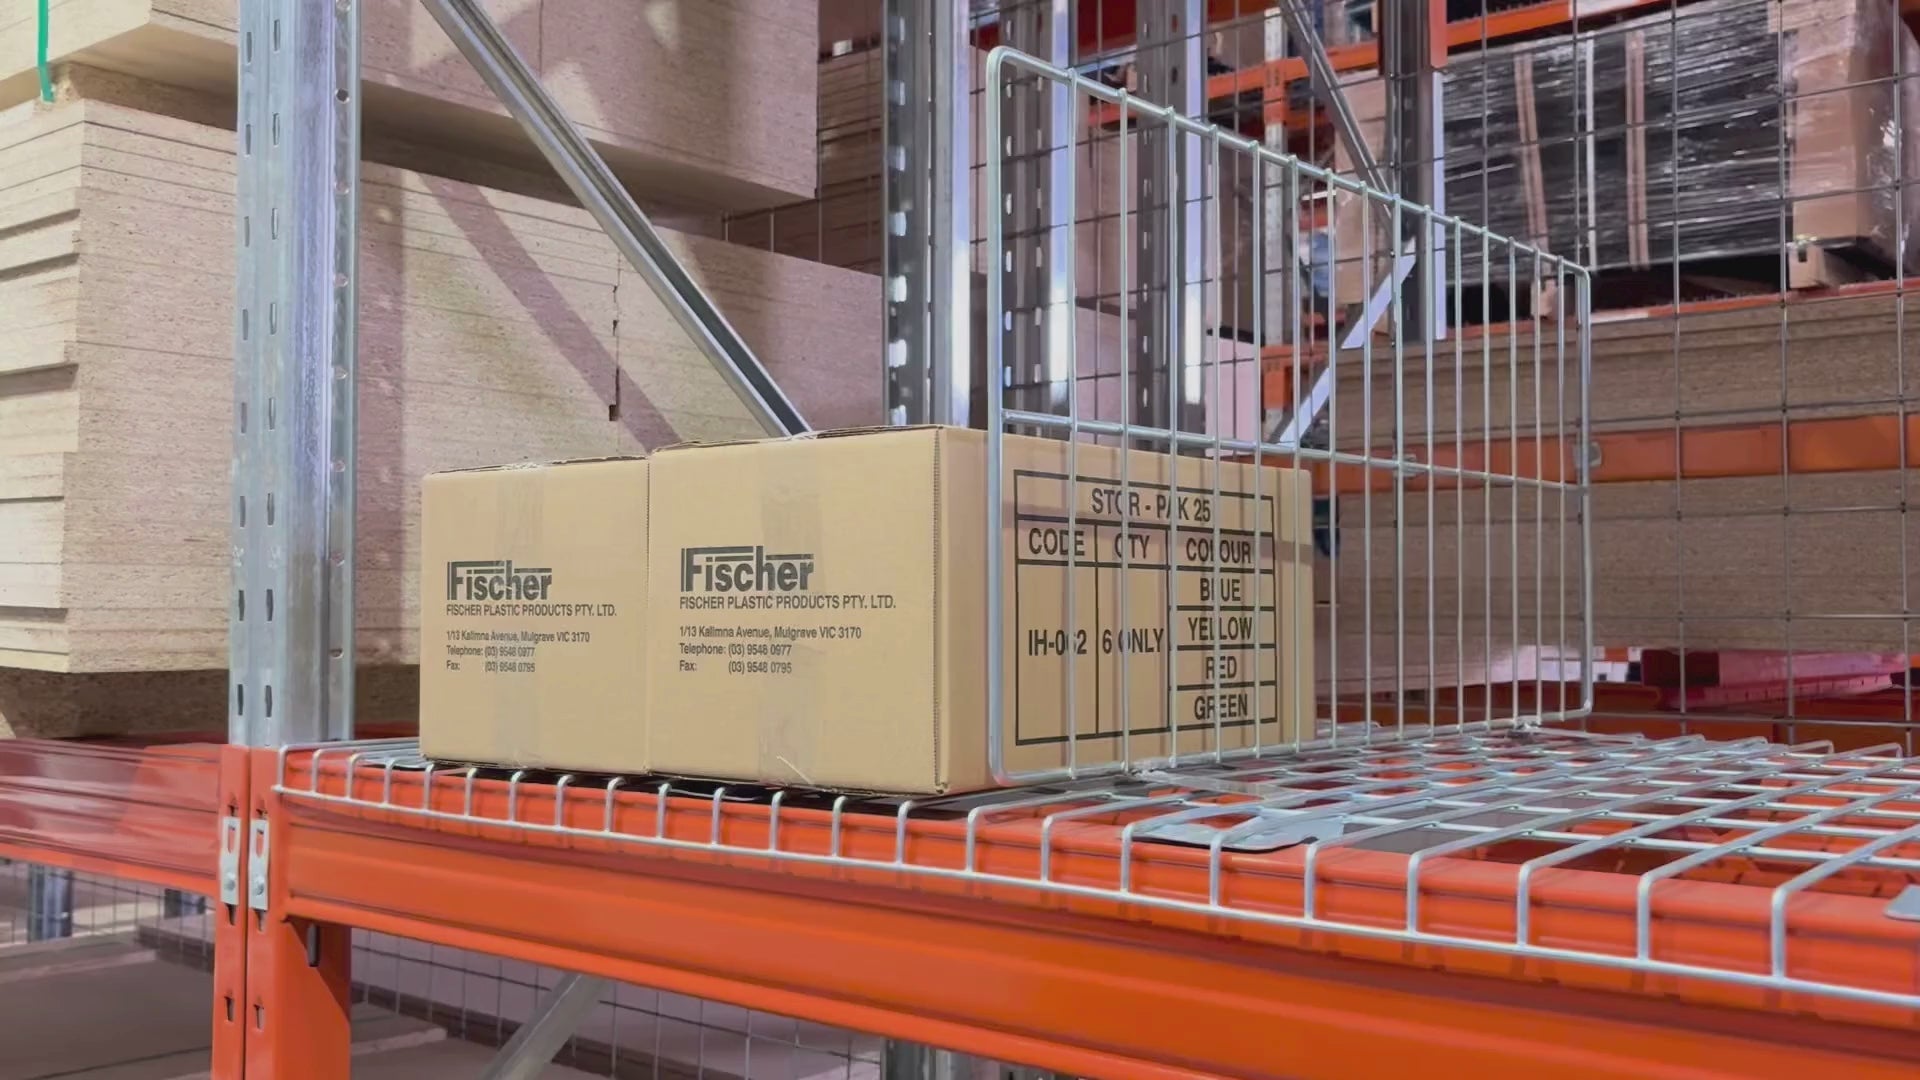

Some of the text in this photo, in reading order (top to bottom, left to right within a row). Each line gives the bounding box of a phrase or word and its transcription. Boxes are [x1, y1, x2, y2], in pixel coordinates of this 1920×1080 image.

[1194, 499, 1211, 522] 25
[1029, 528, 1085, 556] CODE
[681, 546, 814, 592] Fischer
[447, 560, 552, 600] Fischer
[446, 604, 617, 616] FISCHER PLASTIC PRODUCTS PTY. LTD.
[680, 595, 896, 609] FISCHER PLASTIC PRODUCTS PTY. LTD.
[447, 630, 590, 644] 1/13 Kalimna Avenue, Mulgrave VIC 3170
[680, 626, 861, 641] 1/13 Kalimna Avenue, Mulgrave VIC 3170
[1188, 617, 1252, 641] YELLOW
[447, 645, 483, 656] Telephone:
[485, 646, 498, 657] (03)
[500, 646, 516, 656] 9548
[680, 643, 792, 656] Telephone: (03) 9548 0977
[1103, 629, 1112, 654] 6
[447, 660, 460, 671] Fax:
[485, 661, 498, 673] (03)
[680, 661, 792, 674] Fax: (03) 9548 0795
[1206, 656, 1237, 679] RED
[1195, 694, 1247, 720] GREEN
